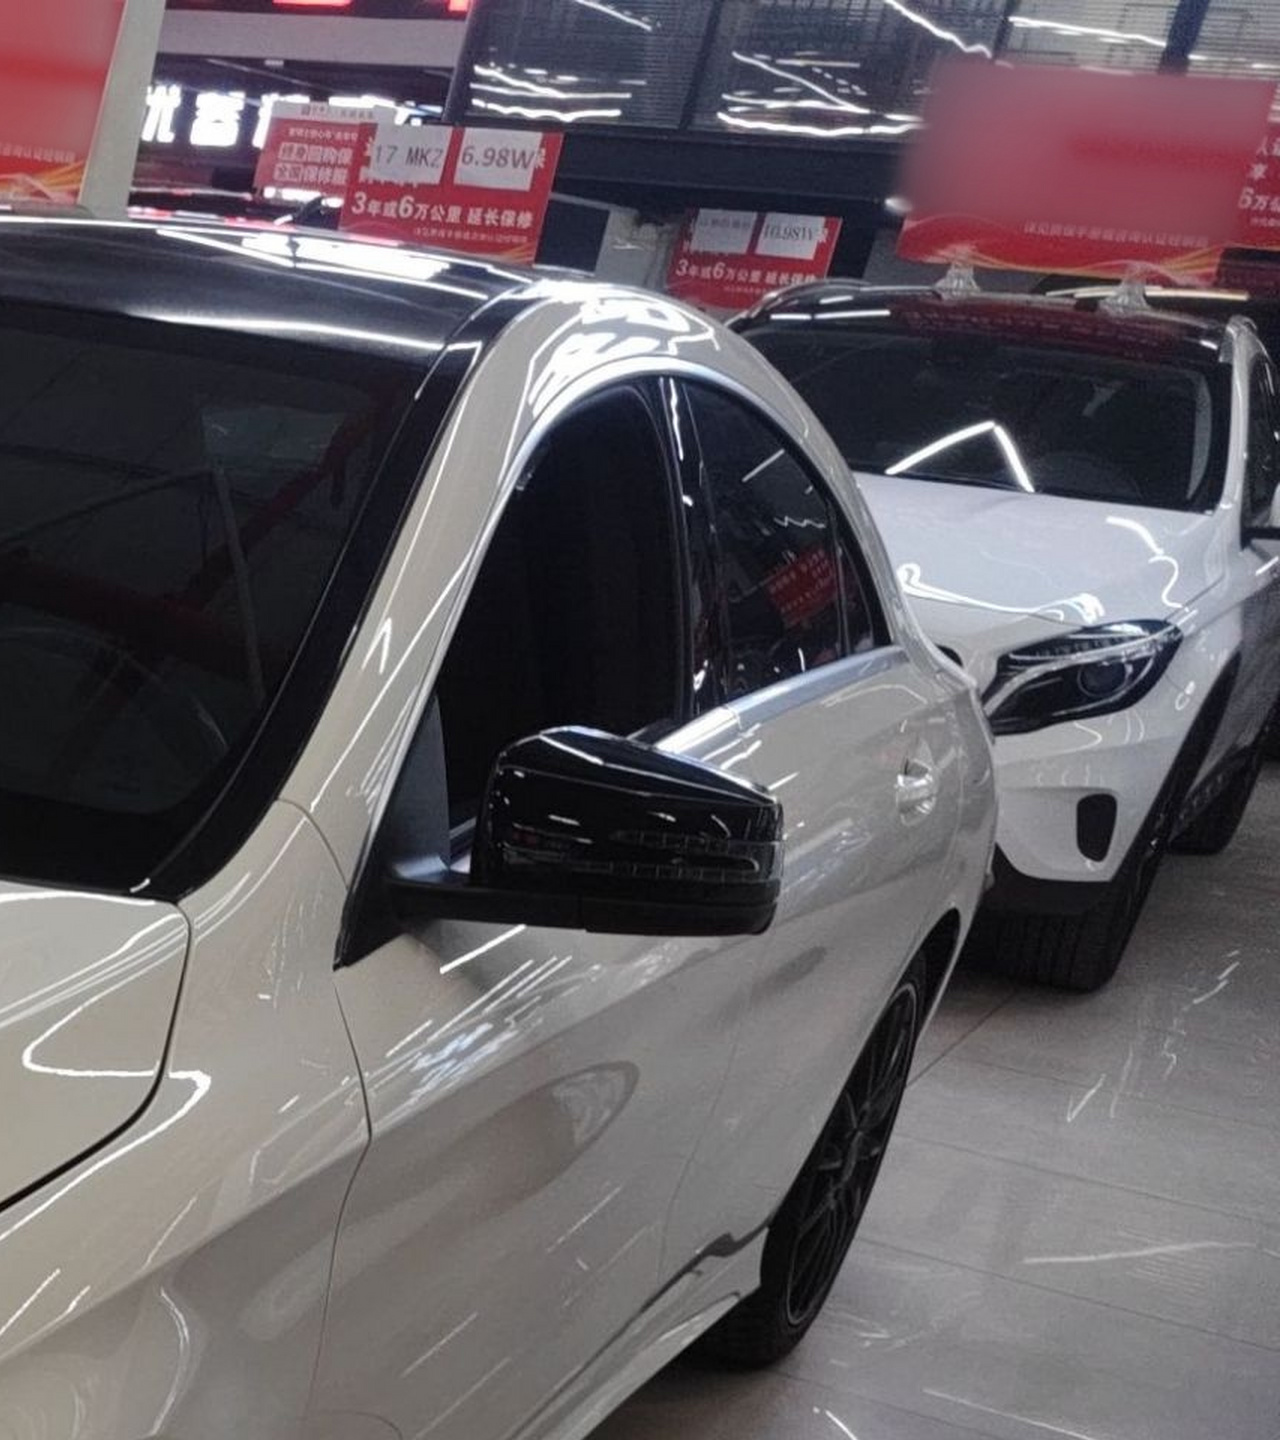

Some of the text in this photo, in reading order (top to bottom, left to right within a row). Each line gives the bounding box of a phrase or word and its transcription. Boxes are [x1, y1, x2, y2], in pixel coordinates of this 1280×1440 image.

[405, 145, 444, 168] MKZ
[461, 144, 535, 169] 6.98W
[351, 191, 534, 230] 3年或6万公里 延长保修
